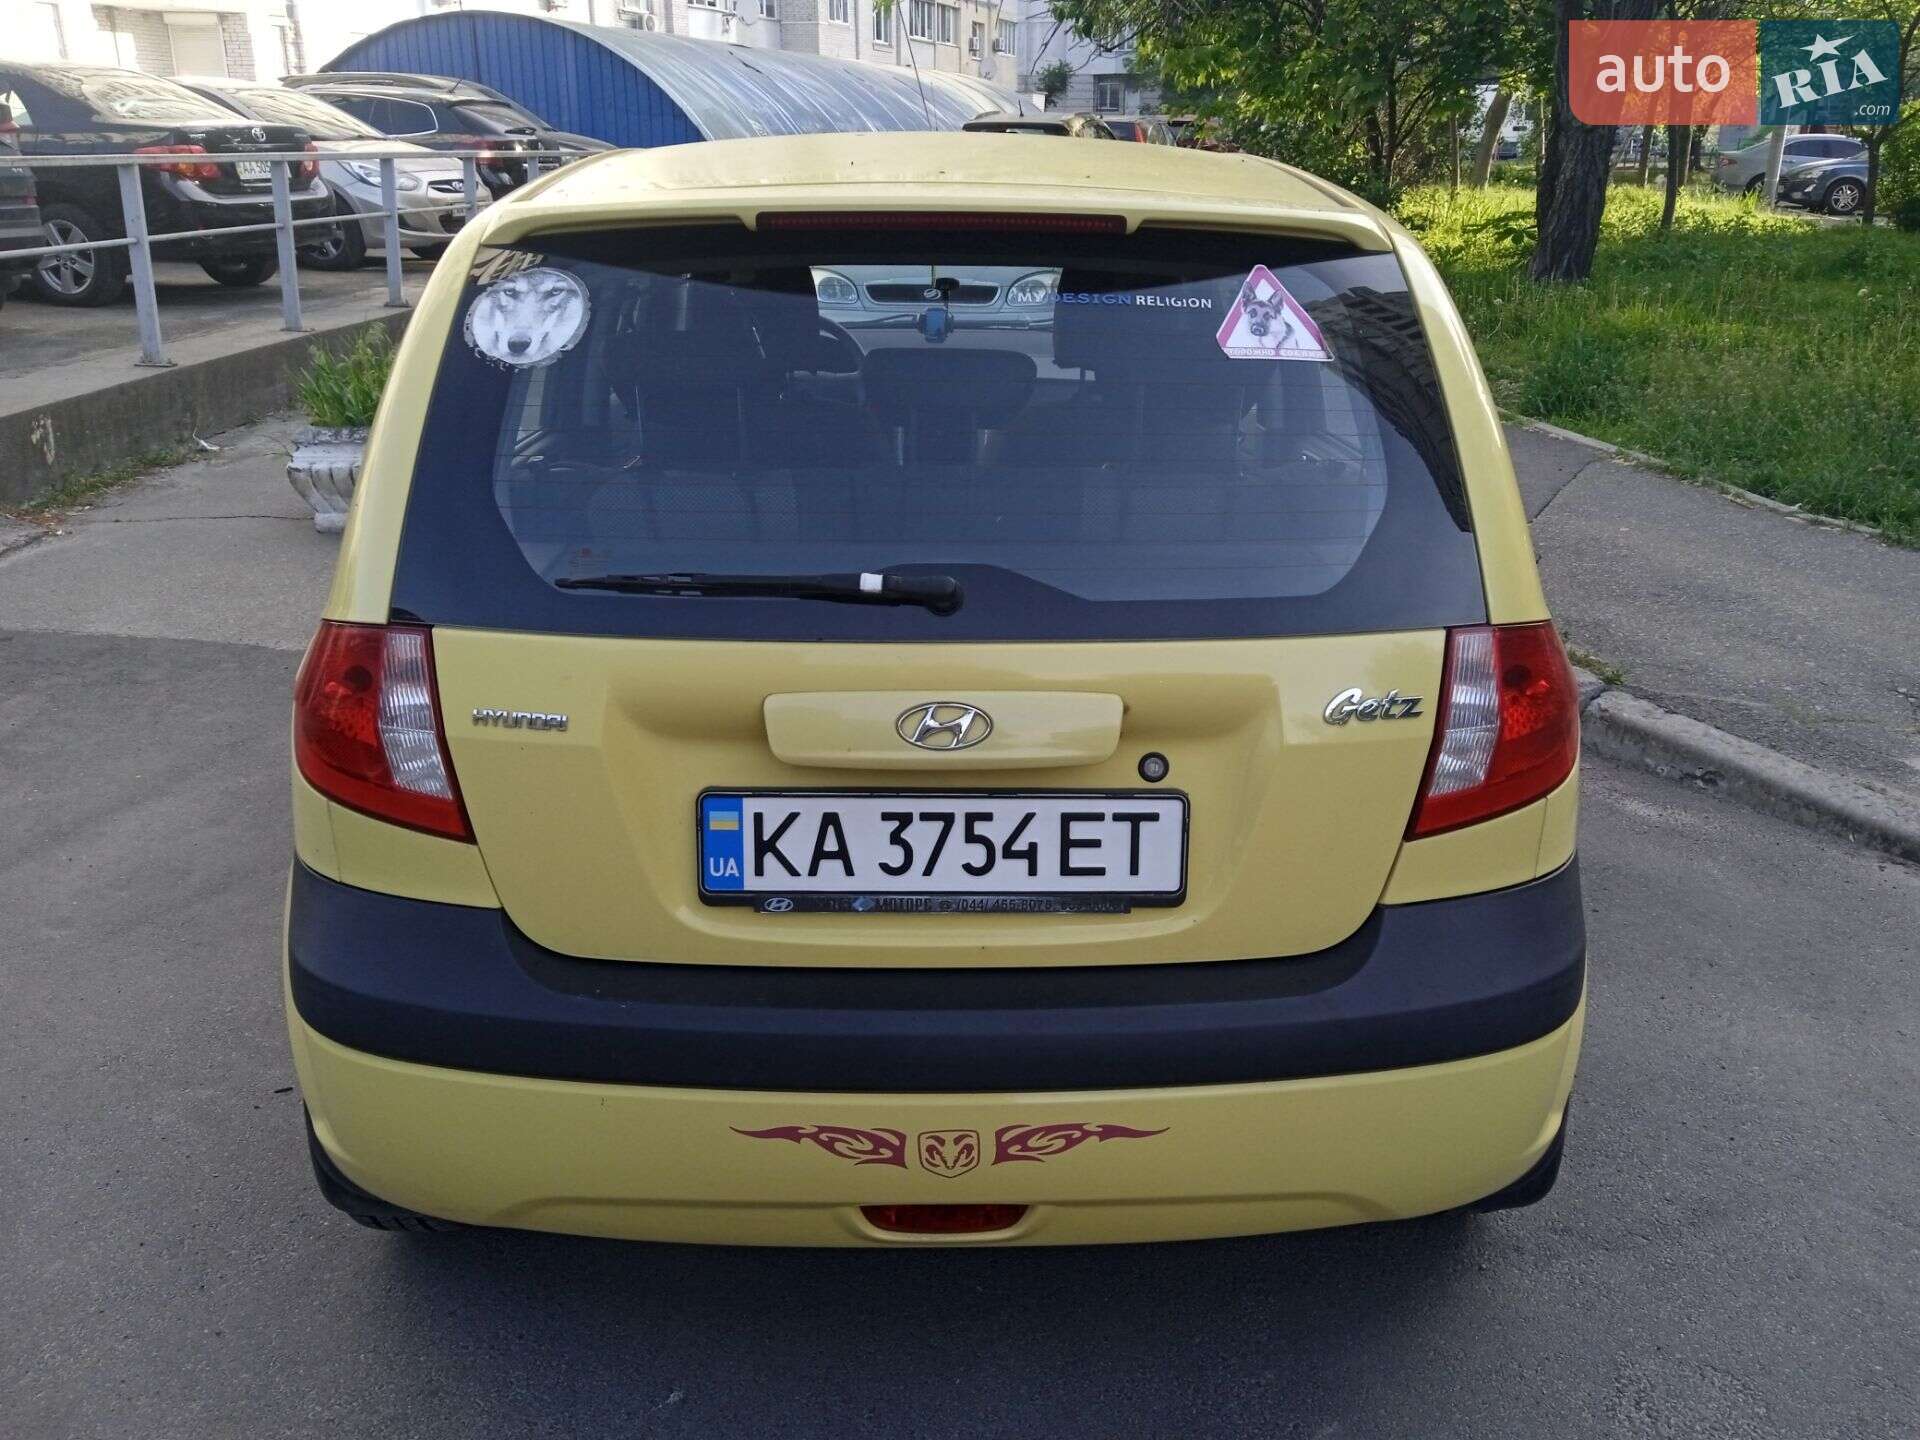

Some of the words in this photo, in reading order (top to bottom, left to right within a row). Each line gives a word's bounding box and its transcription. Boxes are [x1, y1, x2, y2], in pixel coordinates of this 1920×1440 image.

[1017, 293, 1045, 303] MY
[1051, 292, 1132, 305] DESIGN
[1135, 294, 1212, 309] RELIGION
[1324, 688, 1424, 725] Getz
[472, 708, 568, 731] HYUNDAI
[753, 811, 855, 877] KA
[877, 811, 1038, 877] 3754
[1059, 811, 1160, 877] ET
[709, 856, 739, 877] UA
